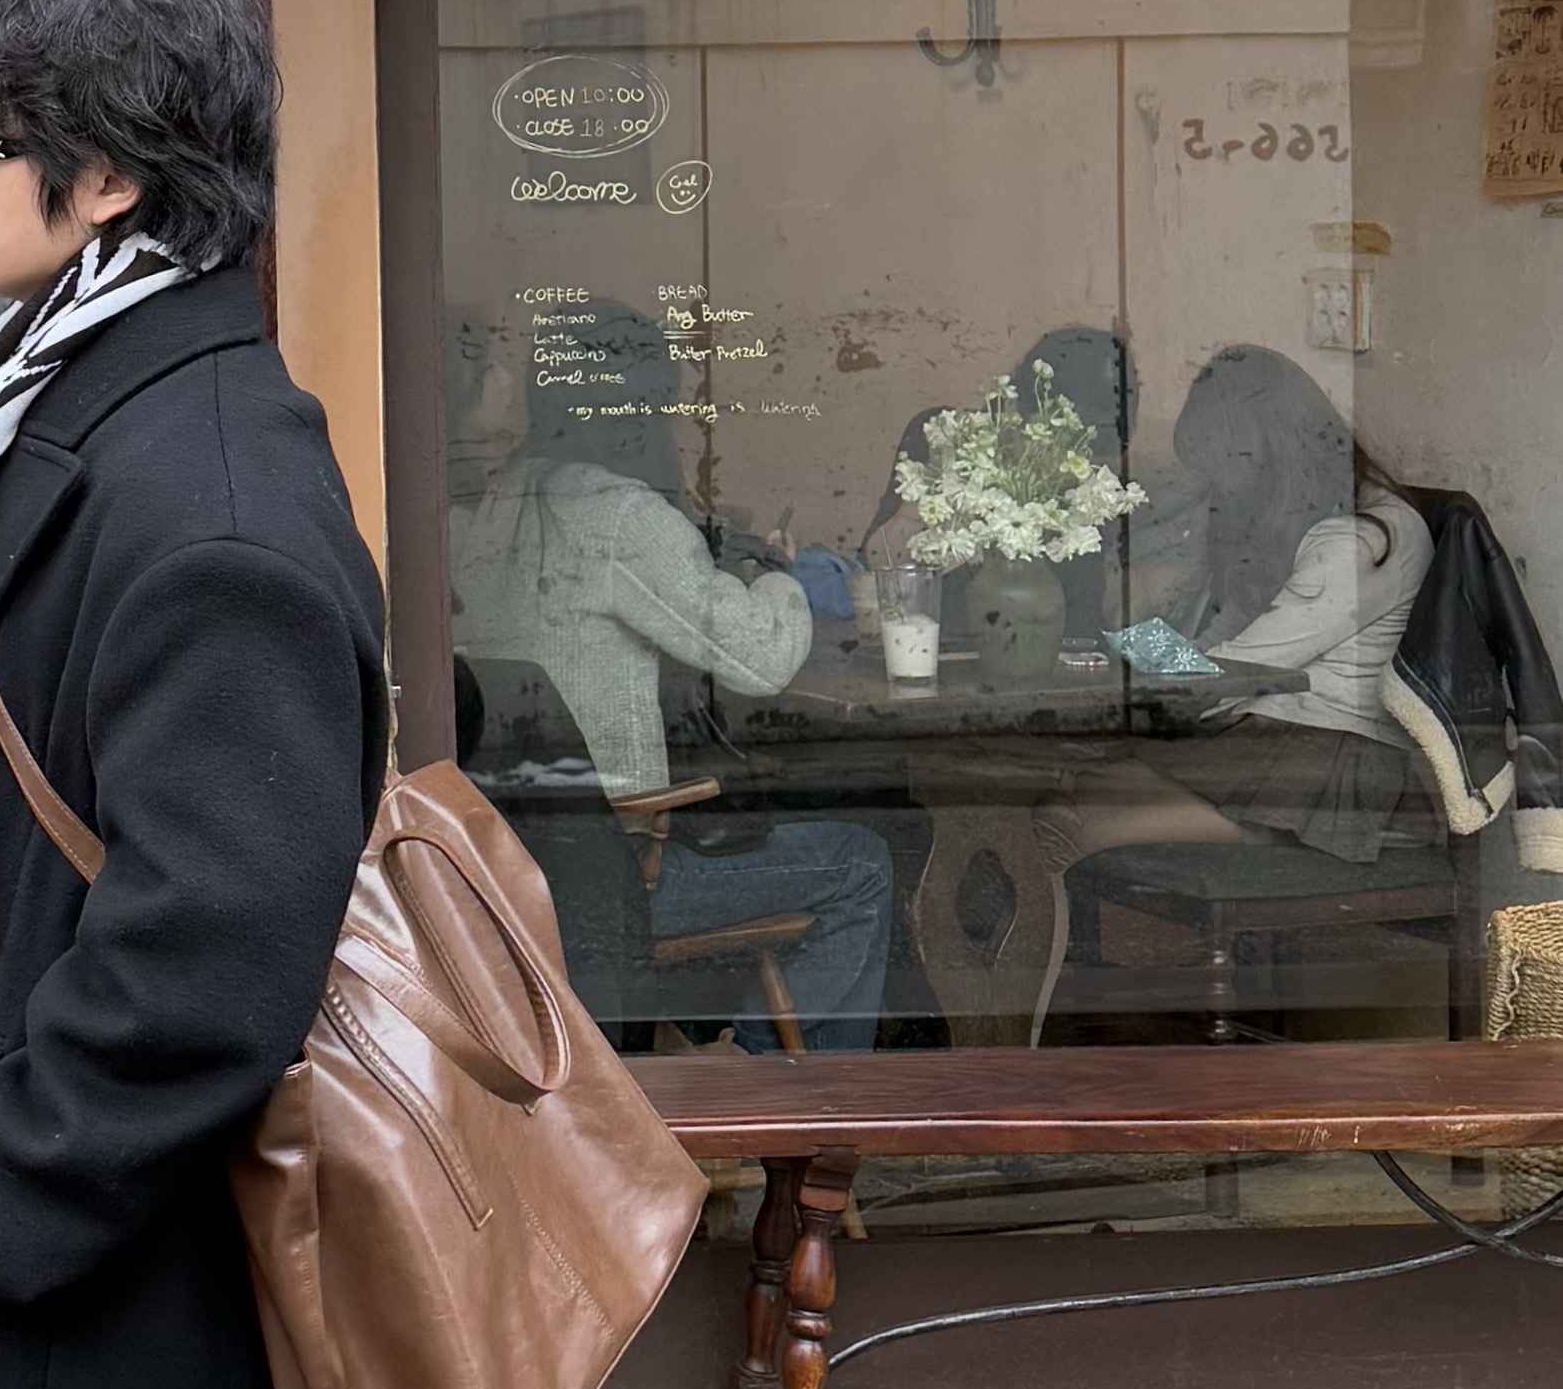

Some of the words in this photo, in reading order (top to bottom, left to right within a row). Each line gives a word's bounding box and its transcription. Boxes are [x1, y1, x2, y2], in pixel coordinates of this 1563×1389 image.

[522, 87, 575, 108] OPEN
[525, 118, 575, 136] CLOSE
[523, 287, 590, 304] COFFEE
[658, 284, 708, 301] BREAD
[534, 333, 578, 345] Latte
